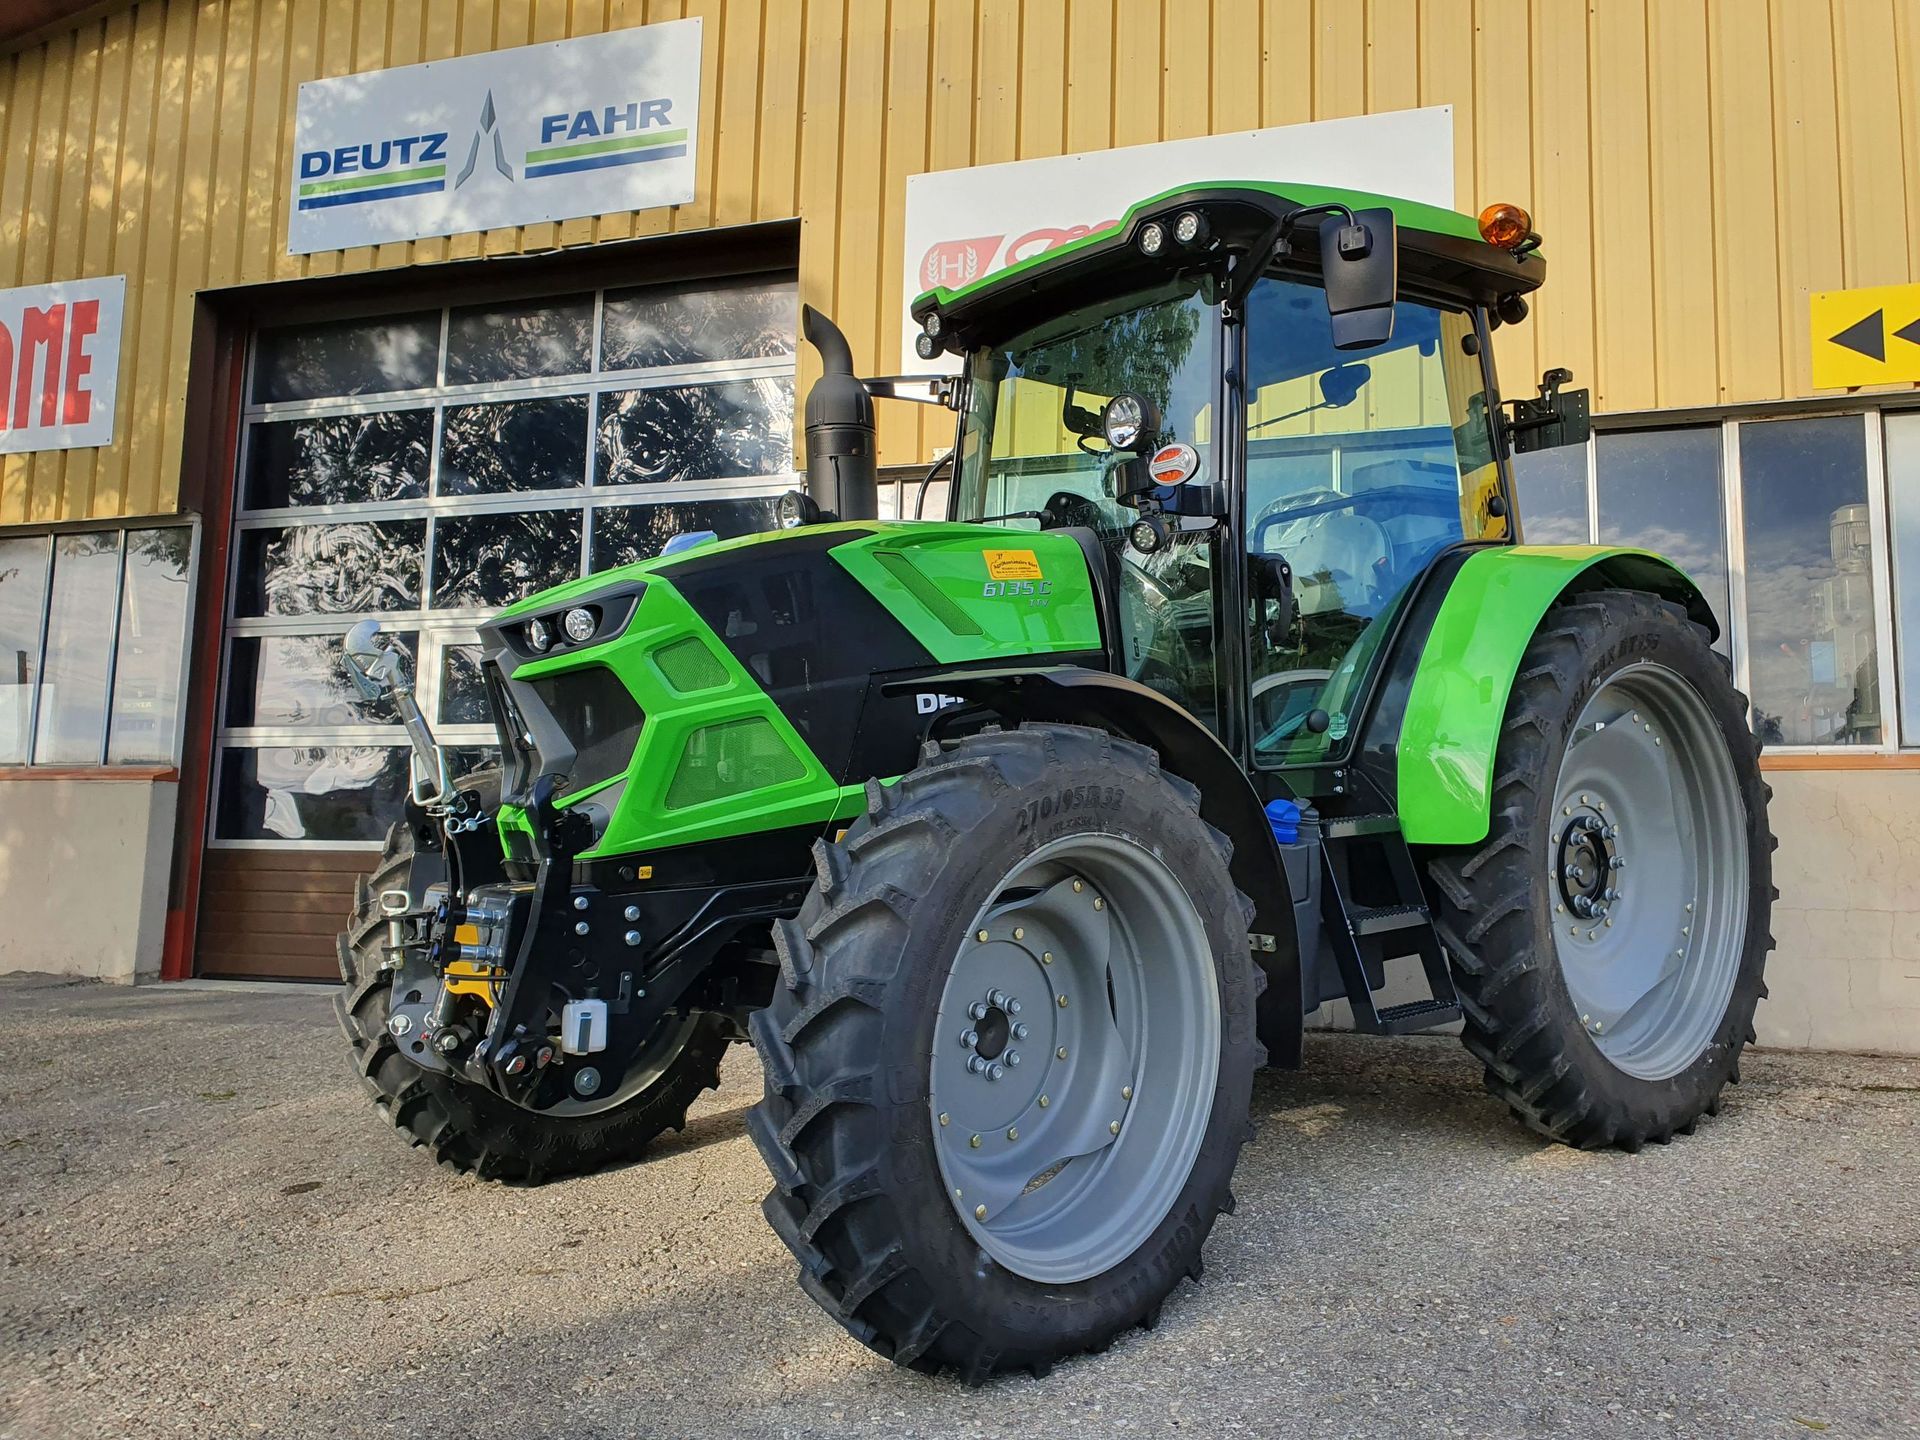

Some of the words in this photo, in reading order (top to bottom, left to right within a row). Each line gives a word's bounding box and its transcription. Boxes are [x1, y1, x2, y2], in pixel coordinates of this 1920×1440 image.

[300, 132, 448, 179] DEUTZ
[541, 98, 673, 144] FAHR
[983, 581, 1035, 598] 6135
[1038, 581, 1053, 595] C
